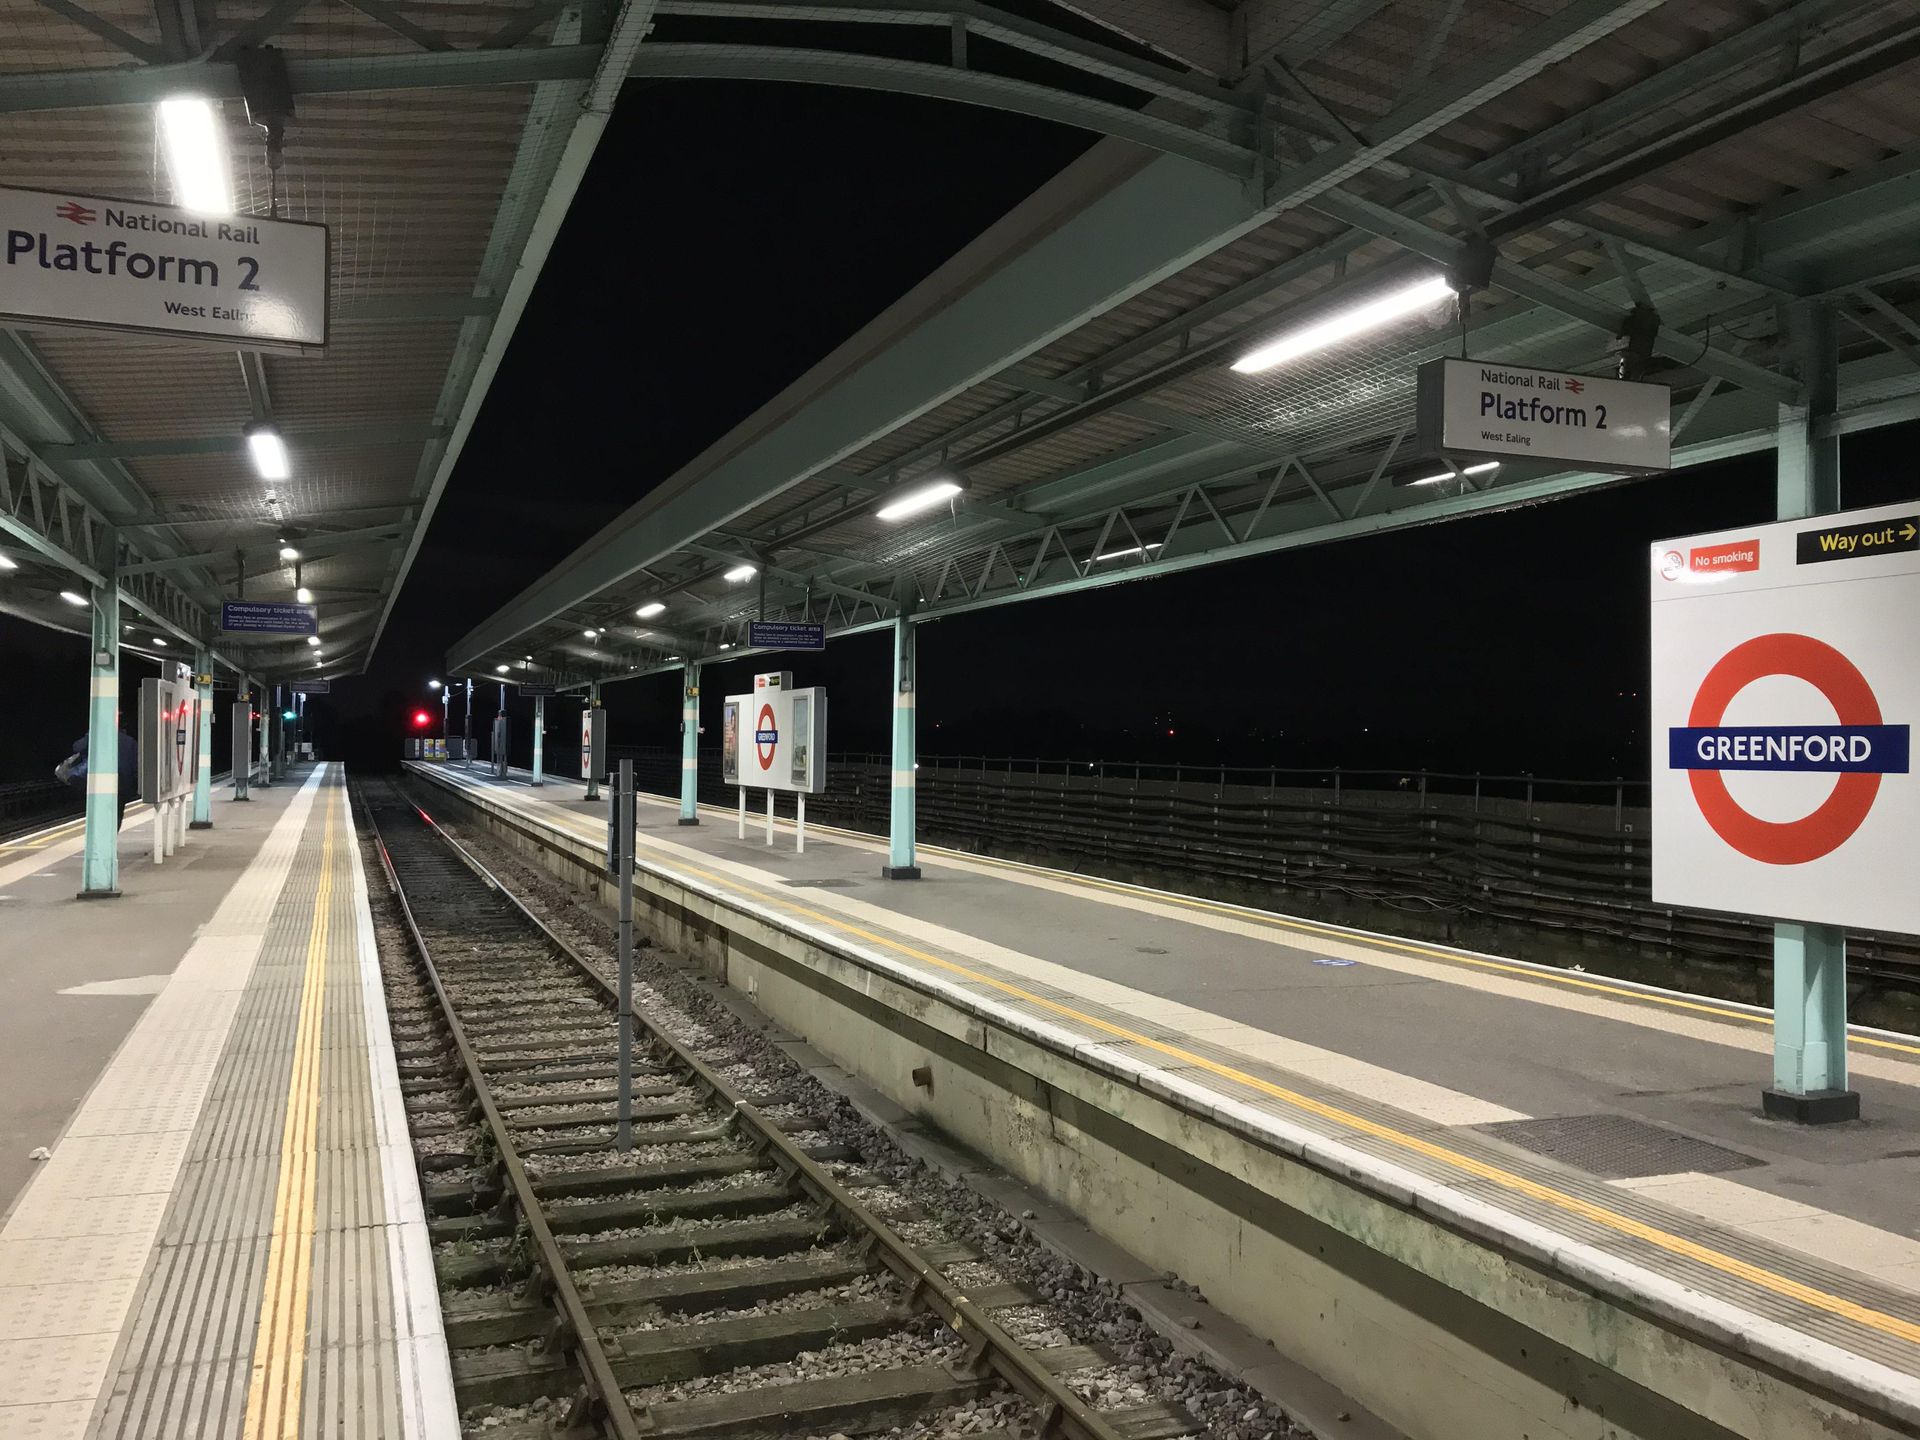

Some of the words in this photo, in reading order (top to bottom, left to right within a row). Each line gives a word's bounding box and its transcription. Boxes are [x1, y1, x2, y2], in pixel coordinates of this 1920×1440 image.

[105, 208, 208, 239] National
[217, 223, 260, 245] Rail
[7, 229, 219, 287] Platform
[237, 257, 260, 291] 2
[164, 301, 206, 318] West
[1480, 369, 1534, 388] National
[1538, 376, 1561, 391] Rail
[1480, 392, 1587, 427] Platform
[1595, 405, 1607, 430] 2
[1481, 431, 1503, 442] West
[1506, 434, 1531, 446] Ealing
[1819, 534, 1858, 552] Way
[1861, 528, 1895, 547] out
[1695, 556, 1710, 567] No
[1712, 550, 1754, 566] smoking
[227, 604, 272, 615] Compulsory
[273, 607, 294, 615] ticket
[753, 623, 788, 632] Compulsory
[789, 624, 807, 632] ticket
[1696, 734, 1872, 763] GREENFORD
